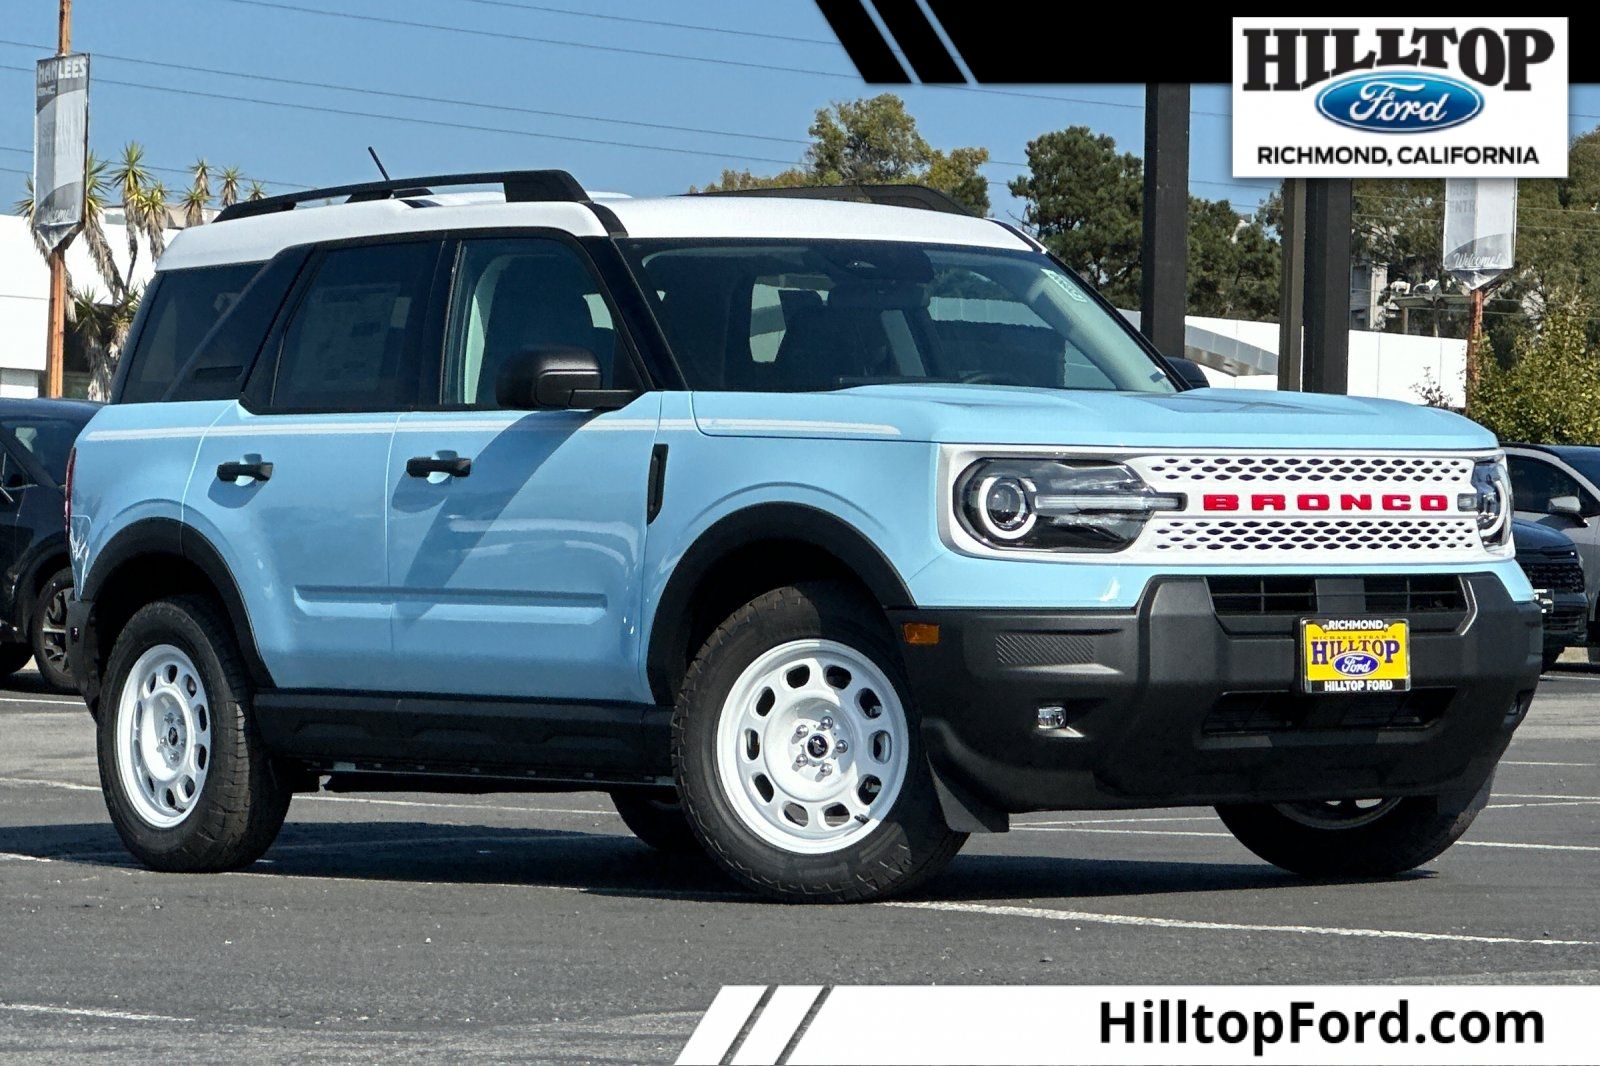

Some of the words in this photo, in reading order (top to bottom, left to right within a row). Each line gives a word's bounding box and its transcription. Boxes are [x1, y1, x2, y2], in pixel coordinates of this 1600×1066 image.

[1453, 252, 1502, 268] Welcome!
[1203, 494, 1448, 511] BRONCO
[1328, 620, 1384, 630] RICHMOND
[1311, 640, 1400, 665] HILLTOP
[1341, 655, 1371, 673] Ford
[1324, 680, 1365, 692] HILLTOP
[1366, 680, 1394, 691] FORD
